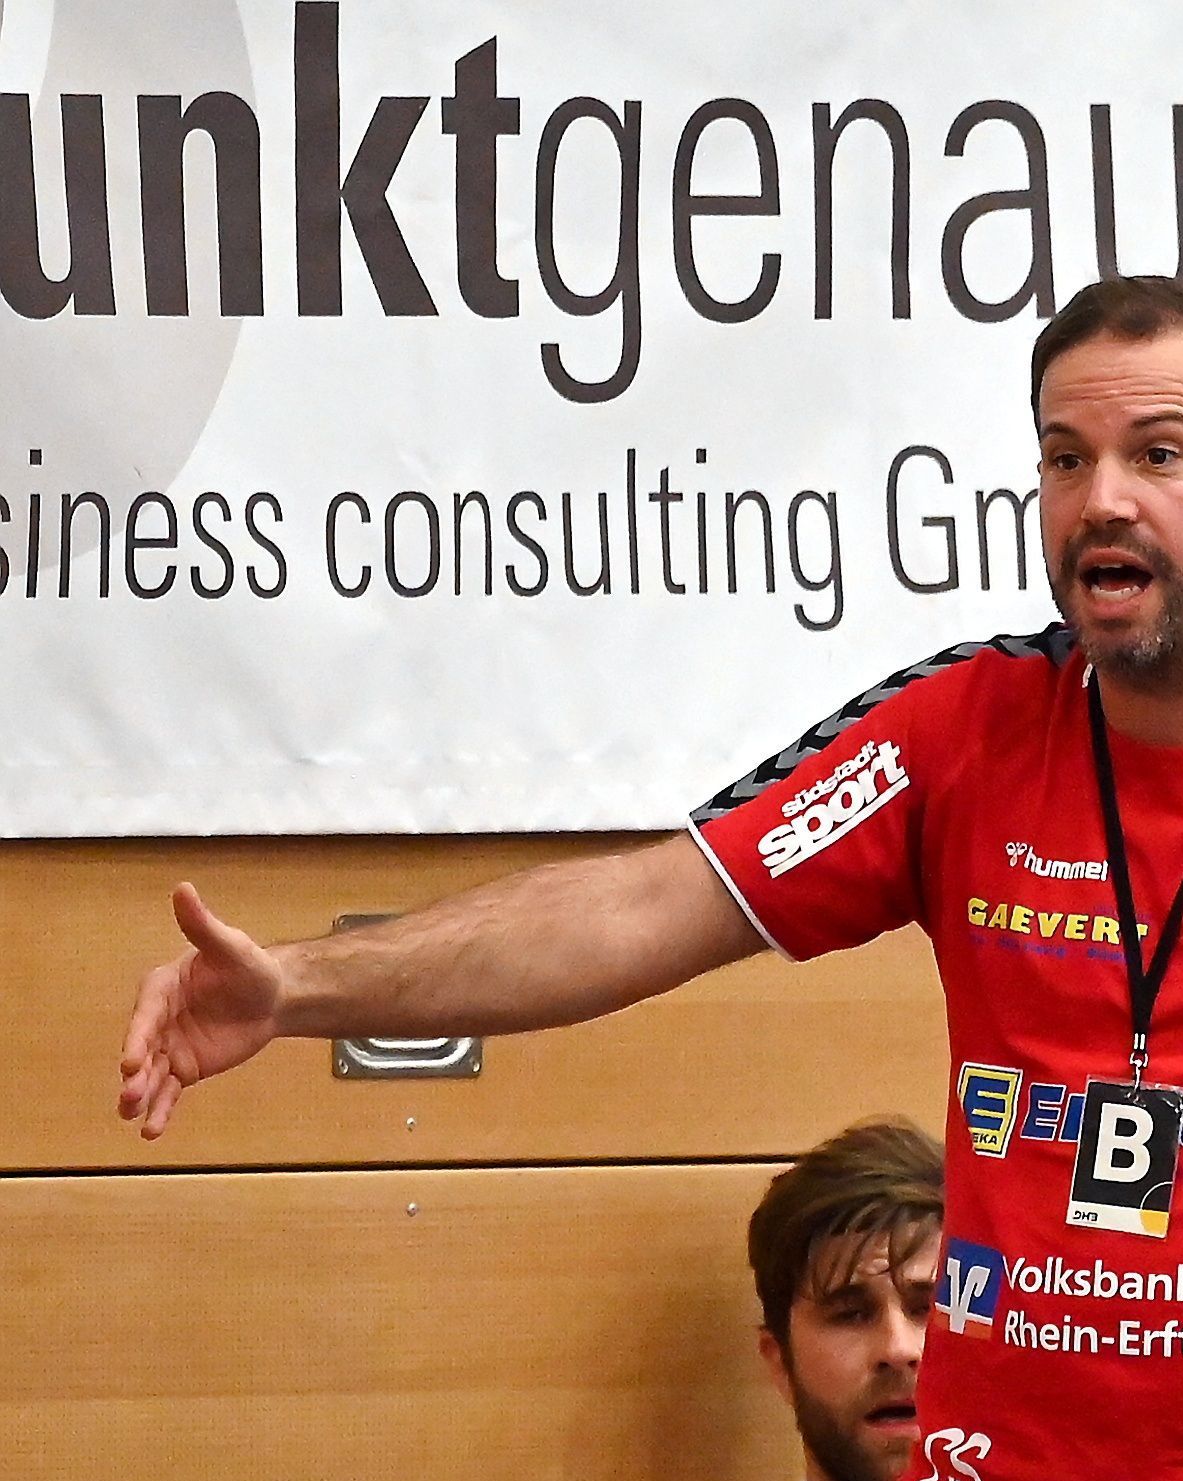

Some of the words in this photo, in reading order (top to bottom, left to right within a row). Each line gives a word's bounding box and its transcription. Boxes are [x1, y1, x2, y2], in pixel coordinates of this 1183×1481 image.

[324, 448, 844, 632] consulting
[757, 740, 907, 868] sport
[781, 740, 877, 818] südstadt
[1024, 846, 1108, 881] hummel
[1092, 1102, 1154, 1183] B
